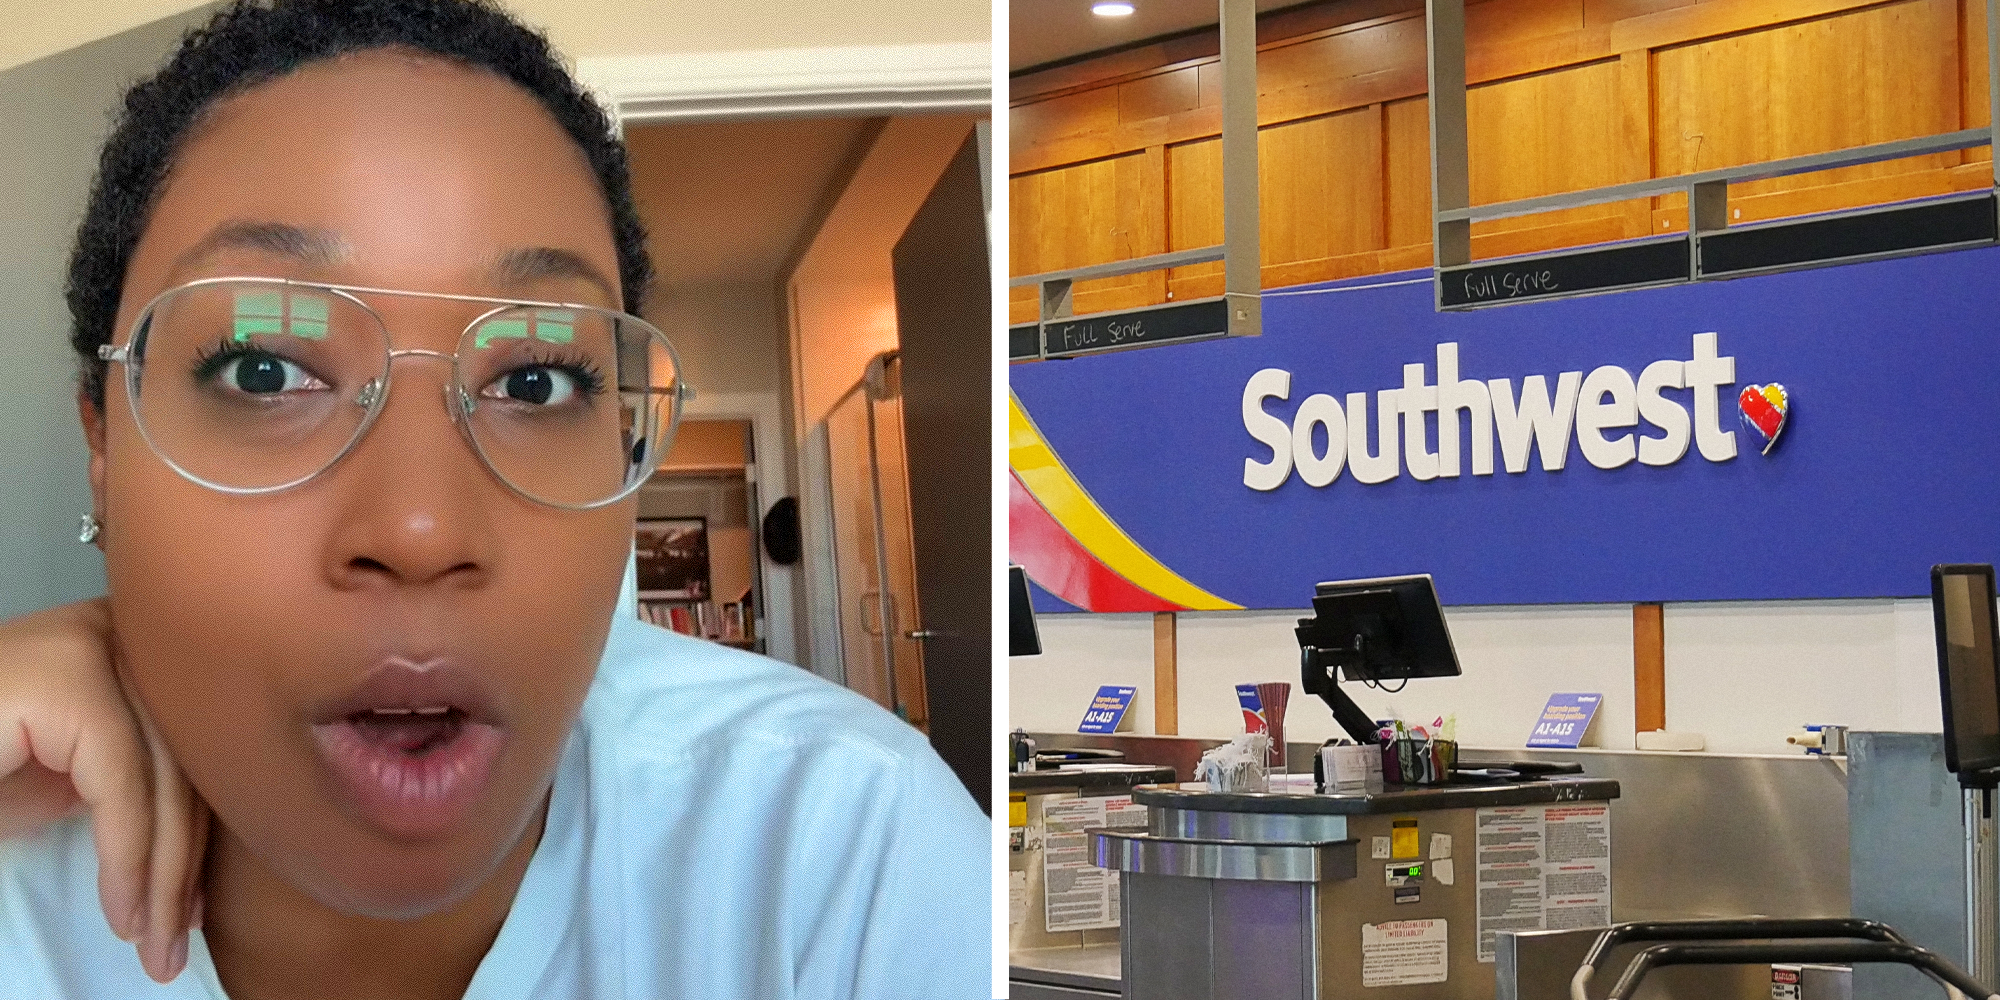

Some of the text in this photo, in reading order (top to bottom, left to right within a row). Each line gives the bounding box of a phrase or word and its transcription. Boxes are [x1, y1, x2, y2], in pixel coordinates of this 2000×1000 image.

[1504, 266, 1559, 296] Serve
[1107, 318, 1146, 342] Serve
[1242, 332, 1737, 491] Southwest
